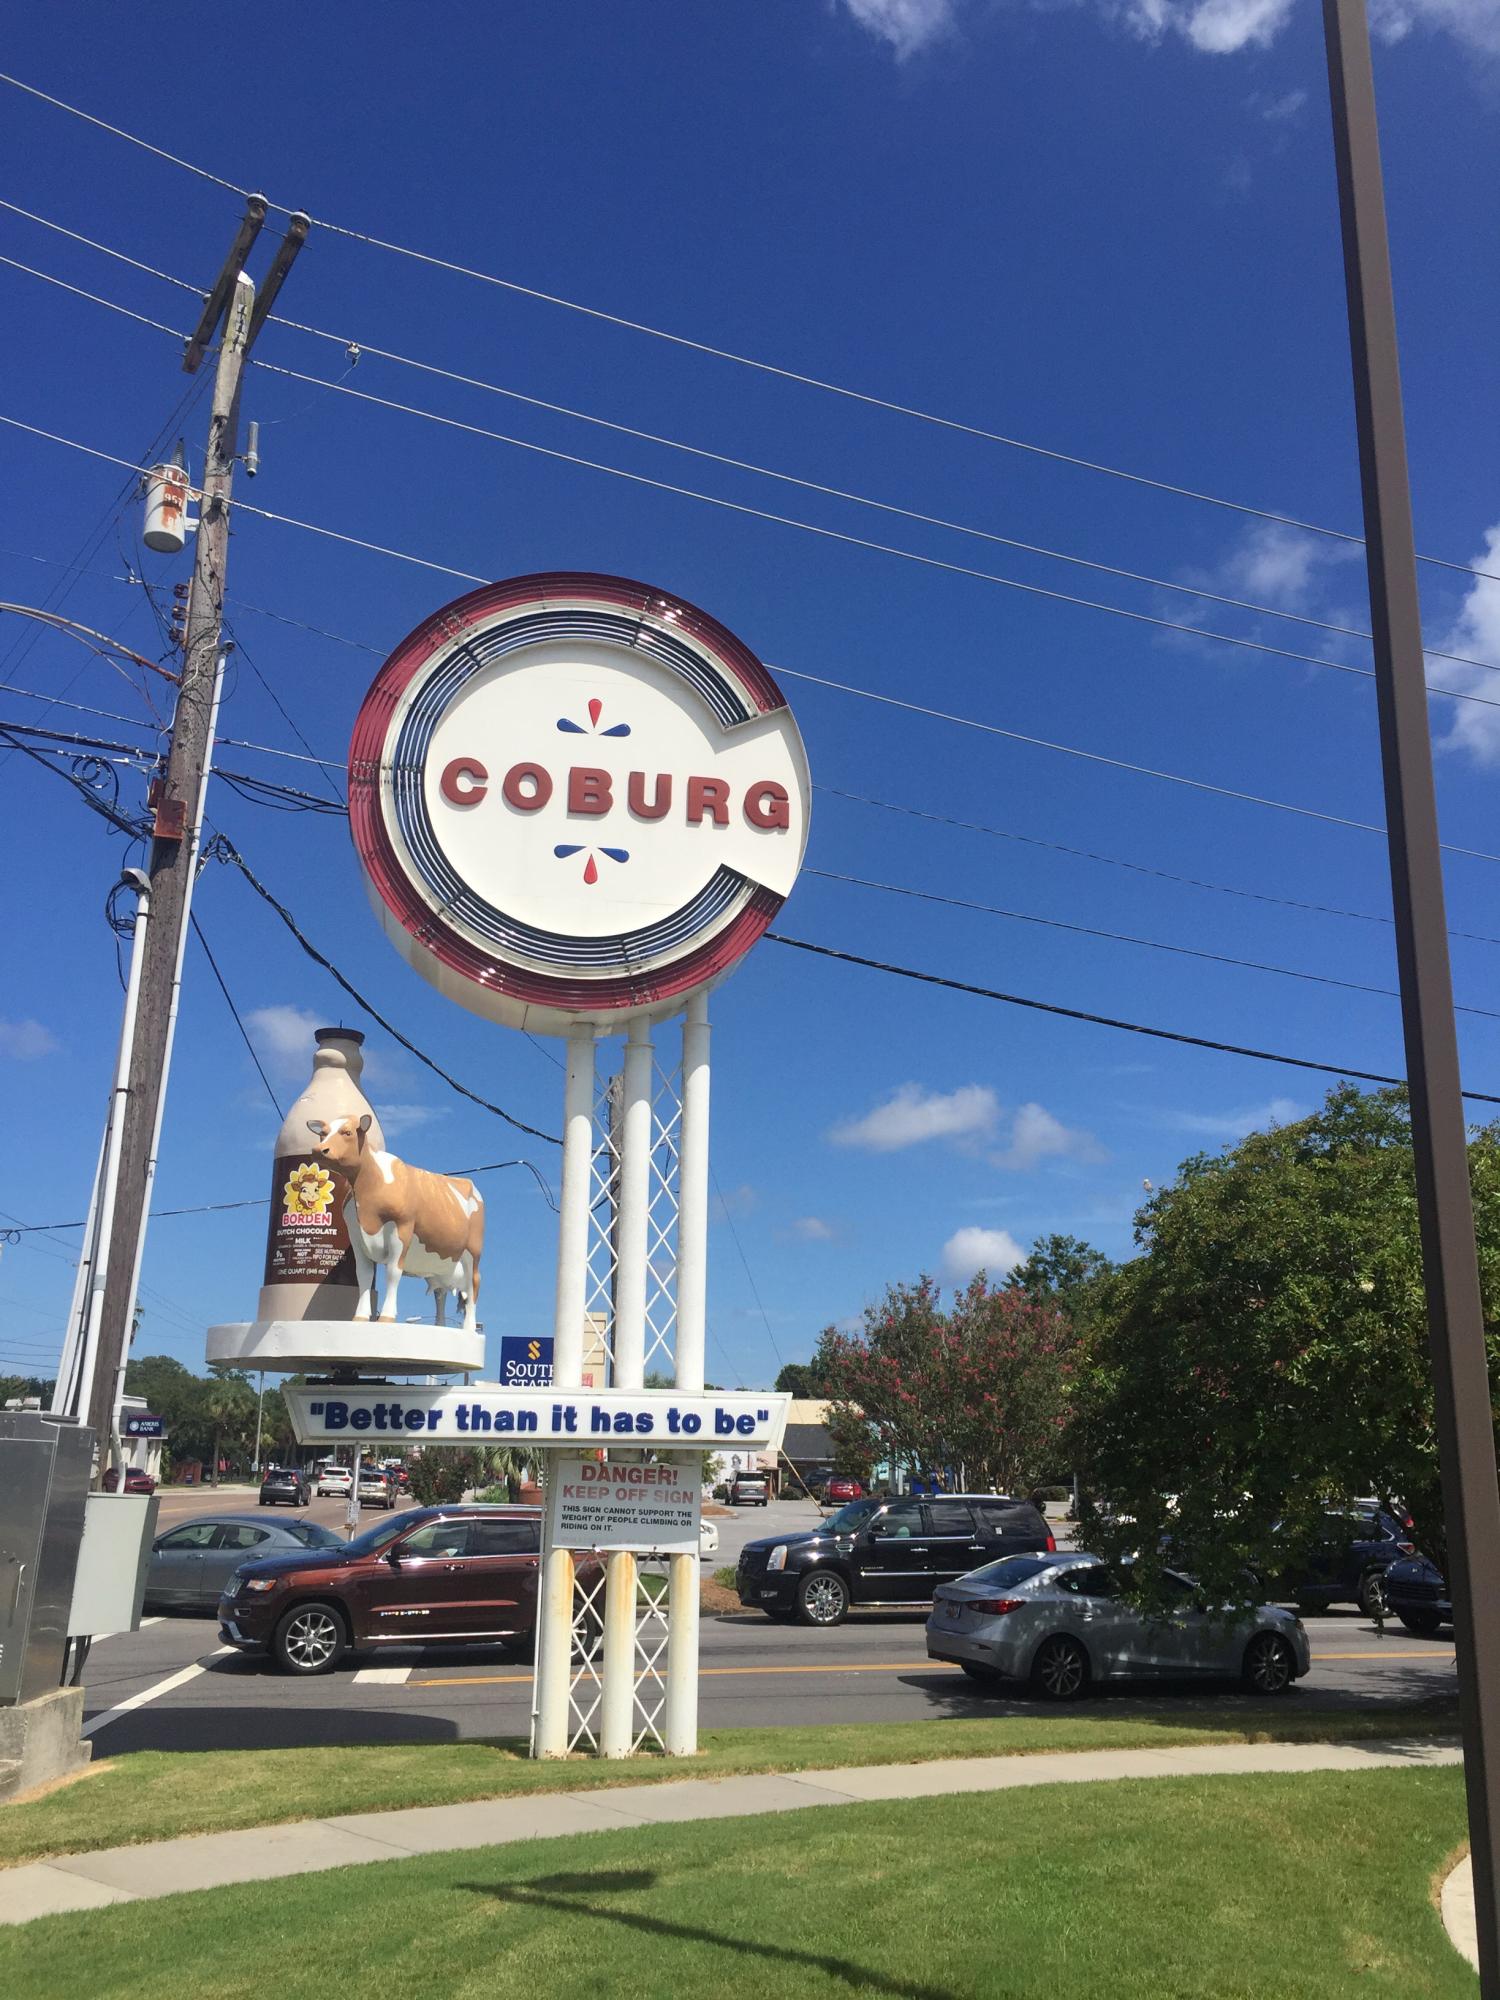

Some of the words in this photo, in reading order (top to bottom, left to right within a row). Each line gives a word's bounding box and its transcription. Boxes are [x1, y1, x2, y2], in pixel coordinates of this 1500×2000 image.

[441, 757, 790, 829] COBURG
[282, 1212, 332, 1226] BORDEN
[311, 1402, 443, 1430] "Better
[455, 1404, 538, 1432] than
[552, 1405, 578, 1432] it
[591, 1406, 654, 1434] has
[667, 1408, 702, 1434] to
[715, 1408, 769, 1434] be"
[581, 1465, 678, 1486] DANGER!
[563, 1485, 610, 1499] KEEP
[615, 1487, 648, 1501] OFF
[654, 1489, 694, 1504] SIGN
[562, 1514, 592, 1522] WEIGHT
[640, 1518, 678, 1526] CLIMBING
[638, 1508, 674, 1516] SUPPORT
